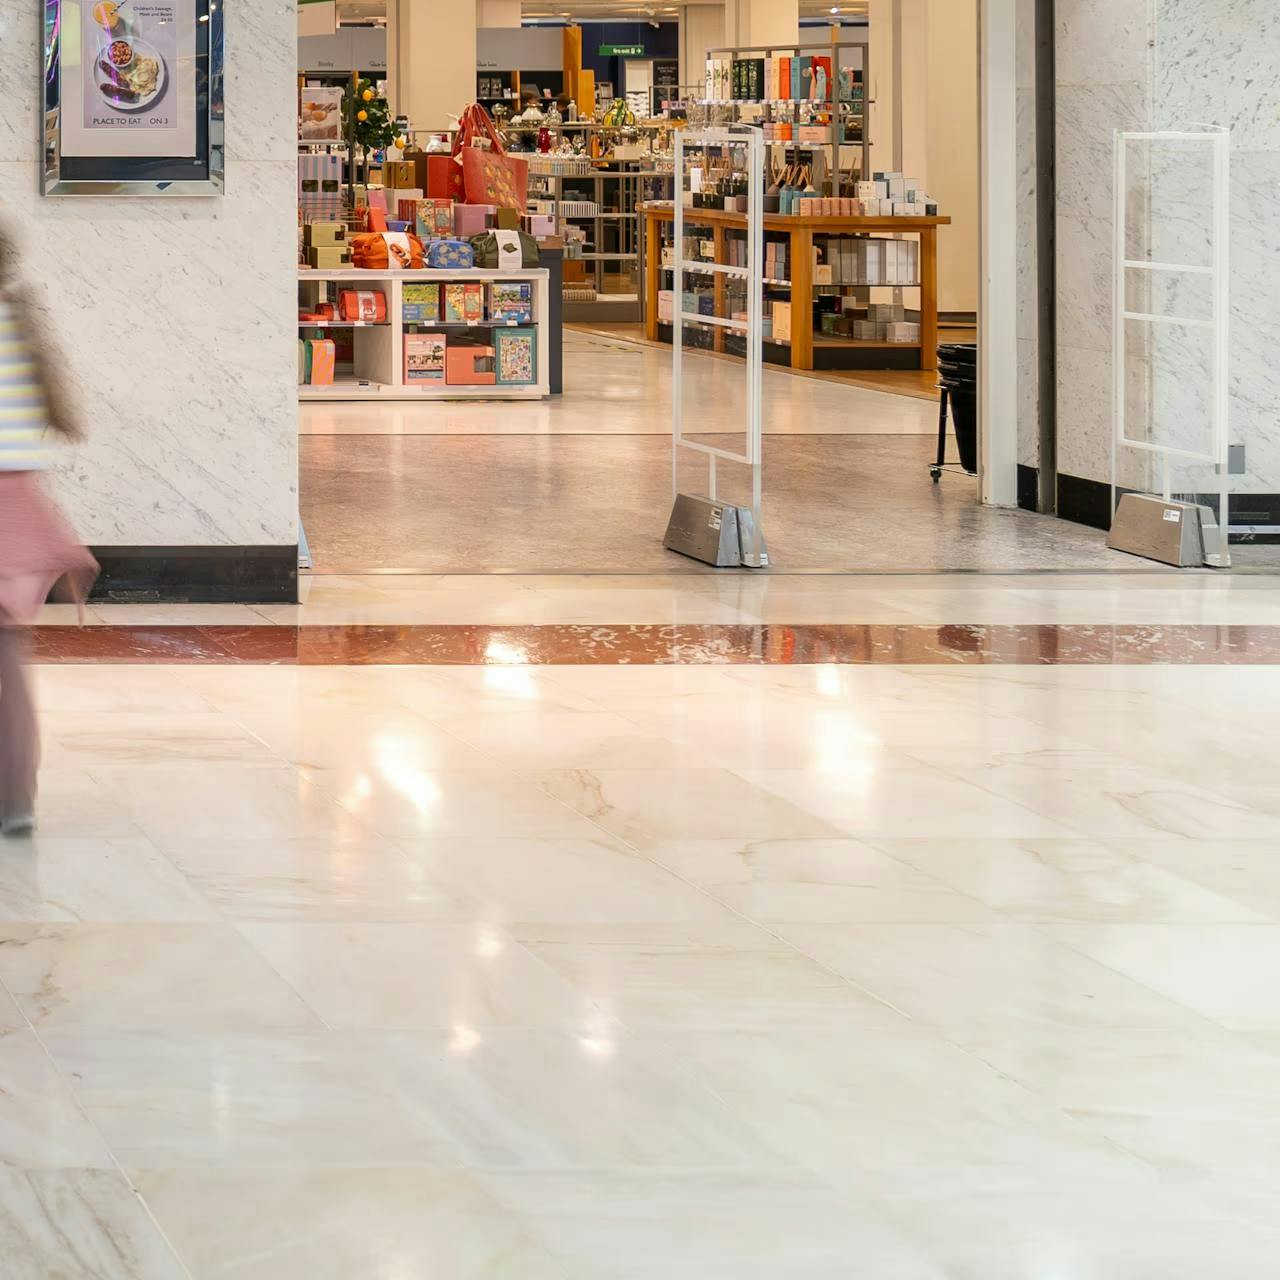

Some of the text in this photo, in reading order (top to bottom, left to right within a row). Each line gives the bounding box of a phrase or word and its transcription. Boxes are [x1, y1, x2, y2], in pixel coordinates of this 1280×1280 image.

[92, 117, 115, 125] PLACE
[116, 117, 127, 125] TO
[128, 117, 142, 125] EAT
[150, 117, 163, 125] ON
